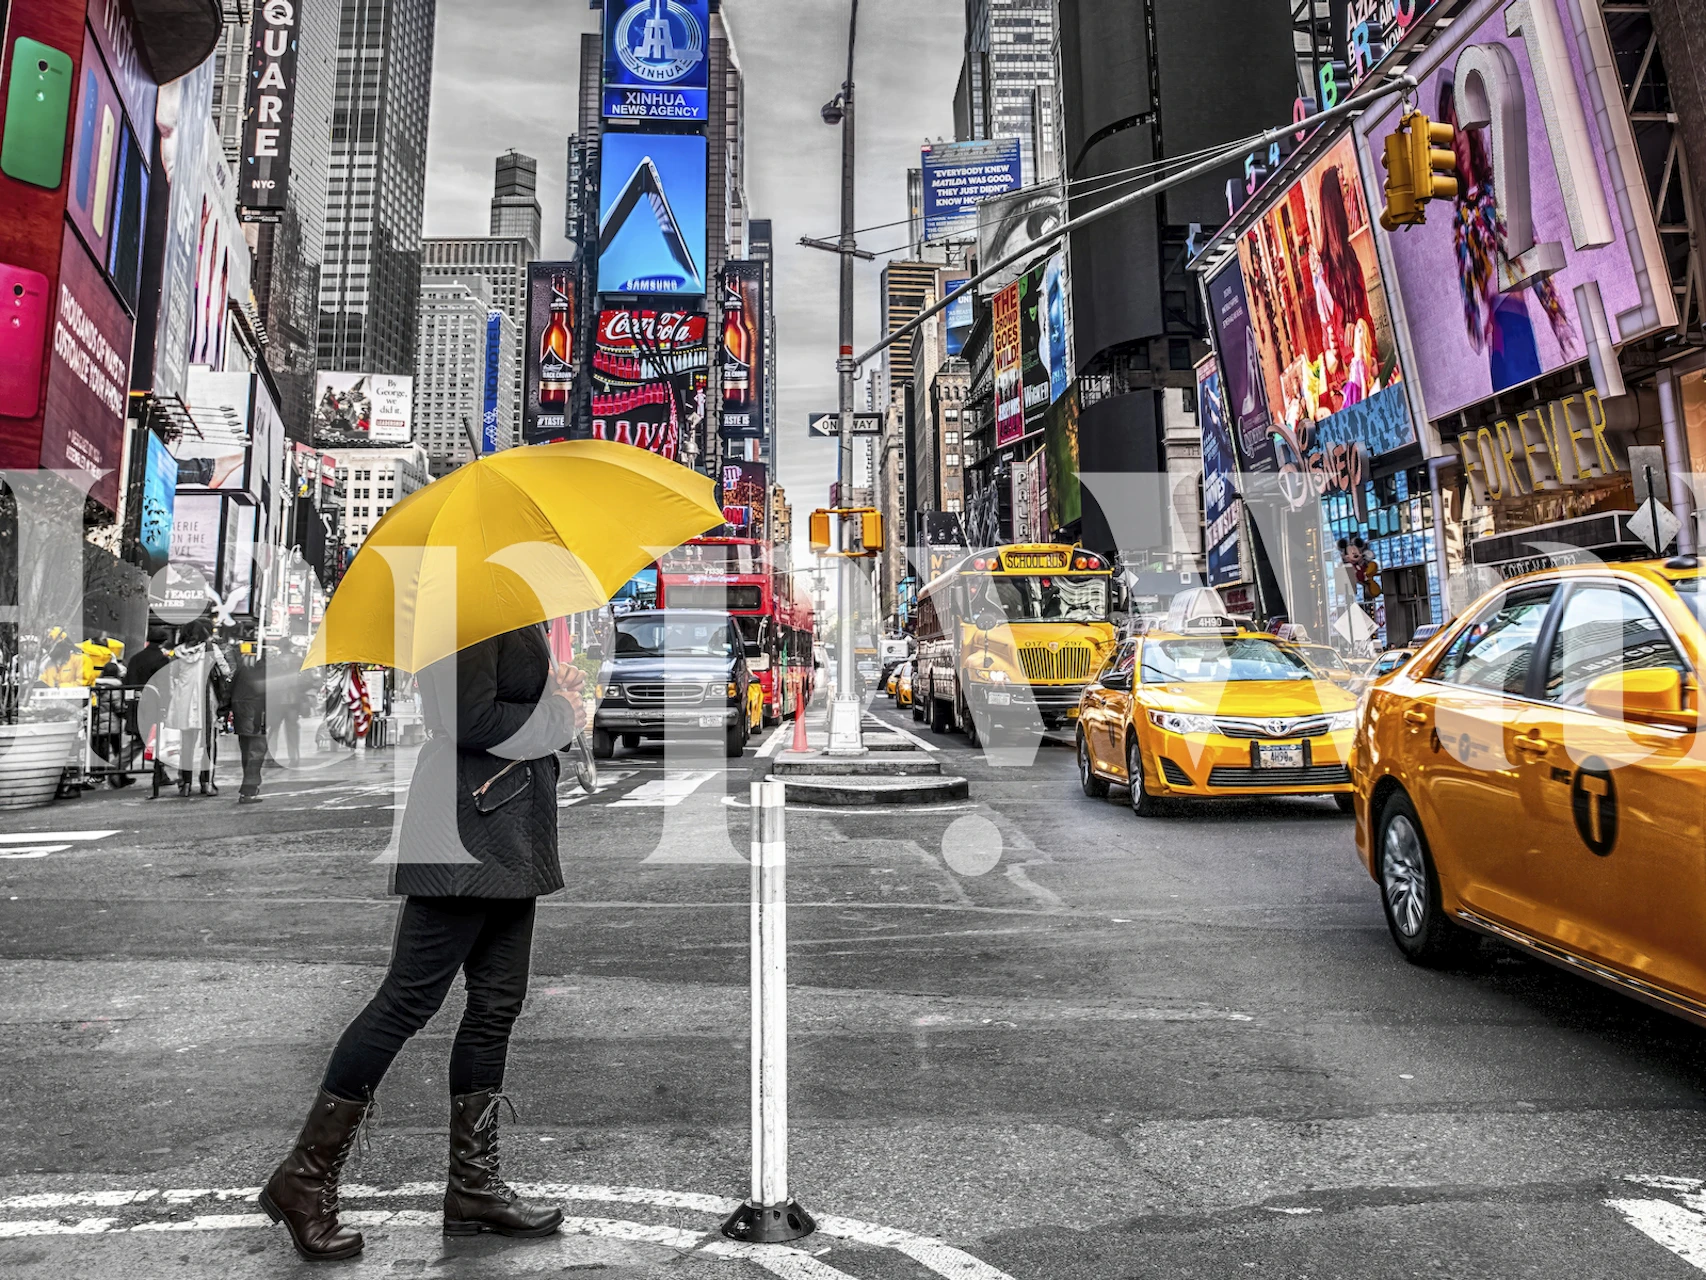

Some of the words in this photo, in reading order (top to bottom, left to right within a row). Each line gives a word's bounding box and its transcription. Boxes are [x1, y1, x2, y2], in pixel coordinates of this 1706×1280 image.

[633, 63, 684, 79] XINHUA
[626, 92, 686, 106] XINHUA
[612, 104, 647, 115] NEWS
[649, 106, 699, 117] AGENCY
[985, 165, 1010, 173] KNEW
[252, 179, 276, 190] NYC
[932, 178, 967, 187] MATILDA
[936, 188, 959, 196] THEY
[959, 186, 979, 195] JUST
[936, 197, 962, 206] KNOW
[626, 279, 678, 291] SAMSUNG
[994, 286, 1018, 319] THE
[60, 283, 98, 354] THOUSANDS
[96, 333, 107, 363] OF
[995, 310, 1018, 334] CROWD
[995, 325, 1018, 352] GOES
[54, 320, 91, 385] CUSTOMIZE
[996, 342, 1020, 371] WILD!
[387, 379, 397, 388] By
[376, 388, 408, 398] George,
[380, 405, 393, 414] did
[537, 416, 564, 426] #TASTE
[1459, 387, 1619, 505] FOREVER
[188, 533, 206, 543] THE
[1007, 555, 1044, 568] SCHOOL
[1046, 555, 1064, 568] BUS
[171, 589, 205, 600] EAGLE
[1198, 617, 1222, 627] 4H90
